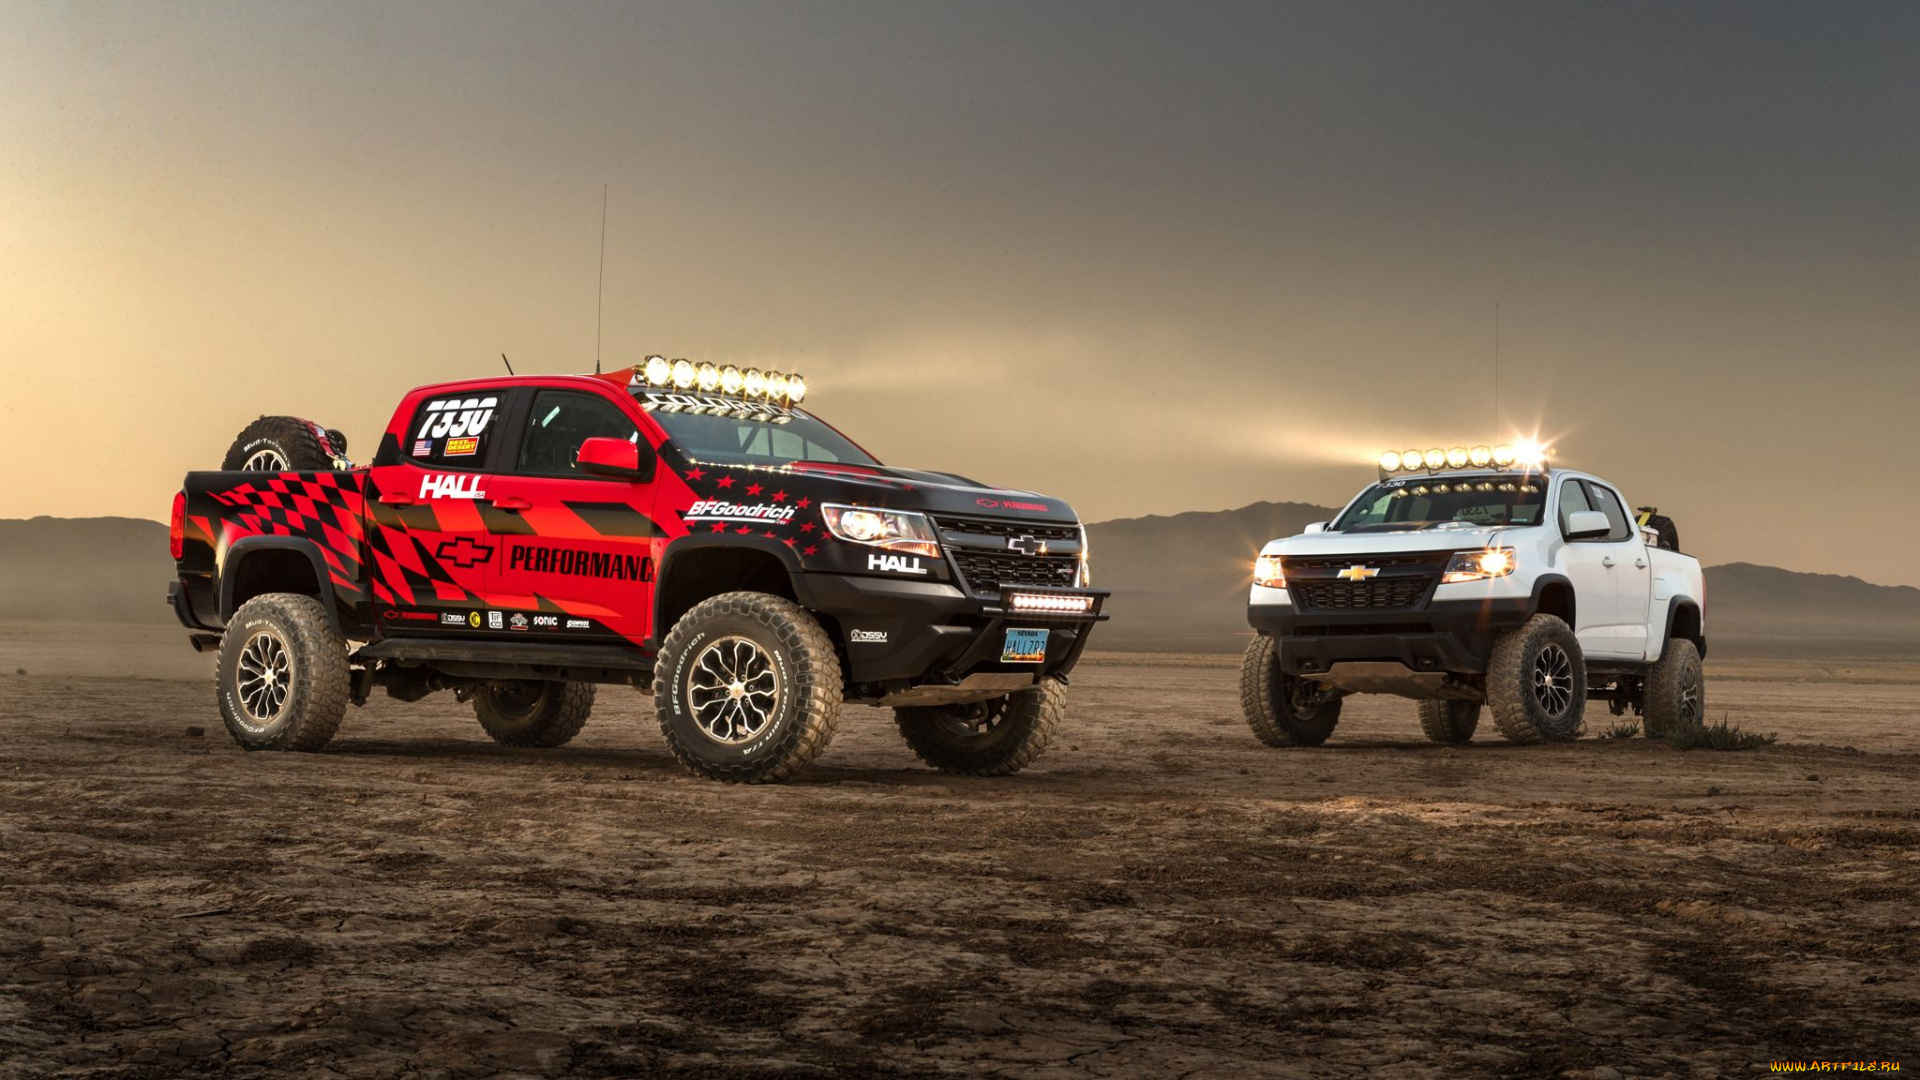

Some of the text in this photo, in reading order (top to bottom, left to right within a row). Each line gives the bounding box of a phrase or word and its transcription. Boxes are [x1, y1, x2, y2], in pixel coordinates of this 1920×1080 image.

[419, 474, 482, 499] HALL
[687, 501, 797, 519] BFGoodrich
[868, 554, 920, 574] HALL
[861, 631, 887, 639] DSSV
[671, 632, 706, 715] BFGoodrich
[765, 649, 789, 741] Mud-Terrain
